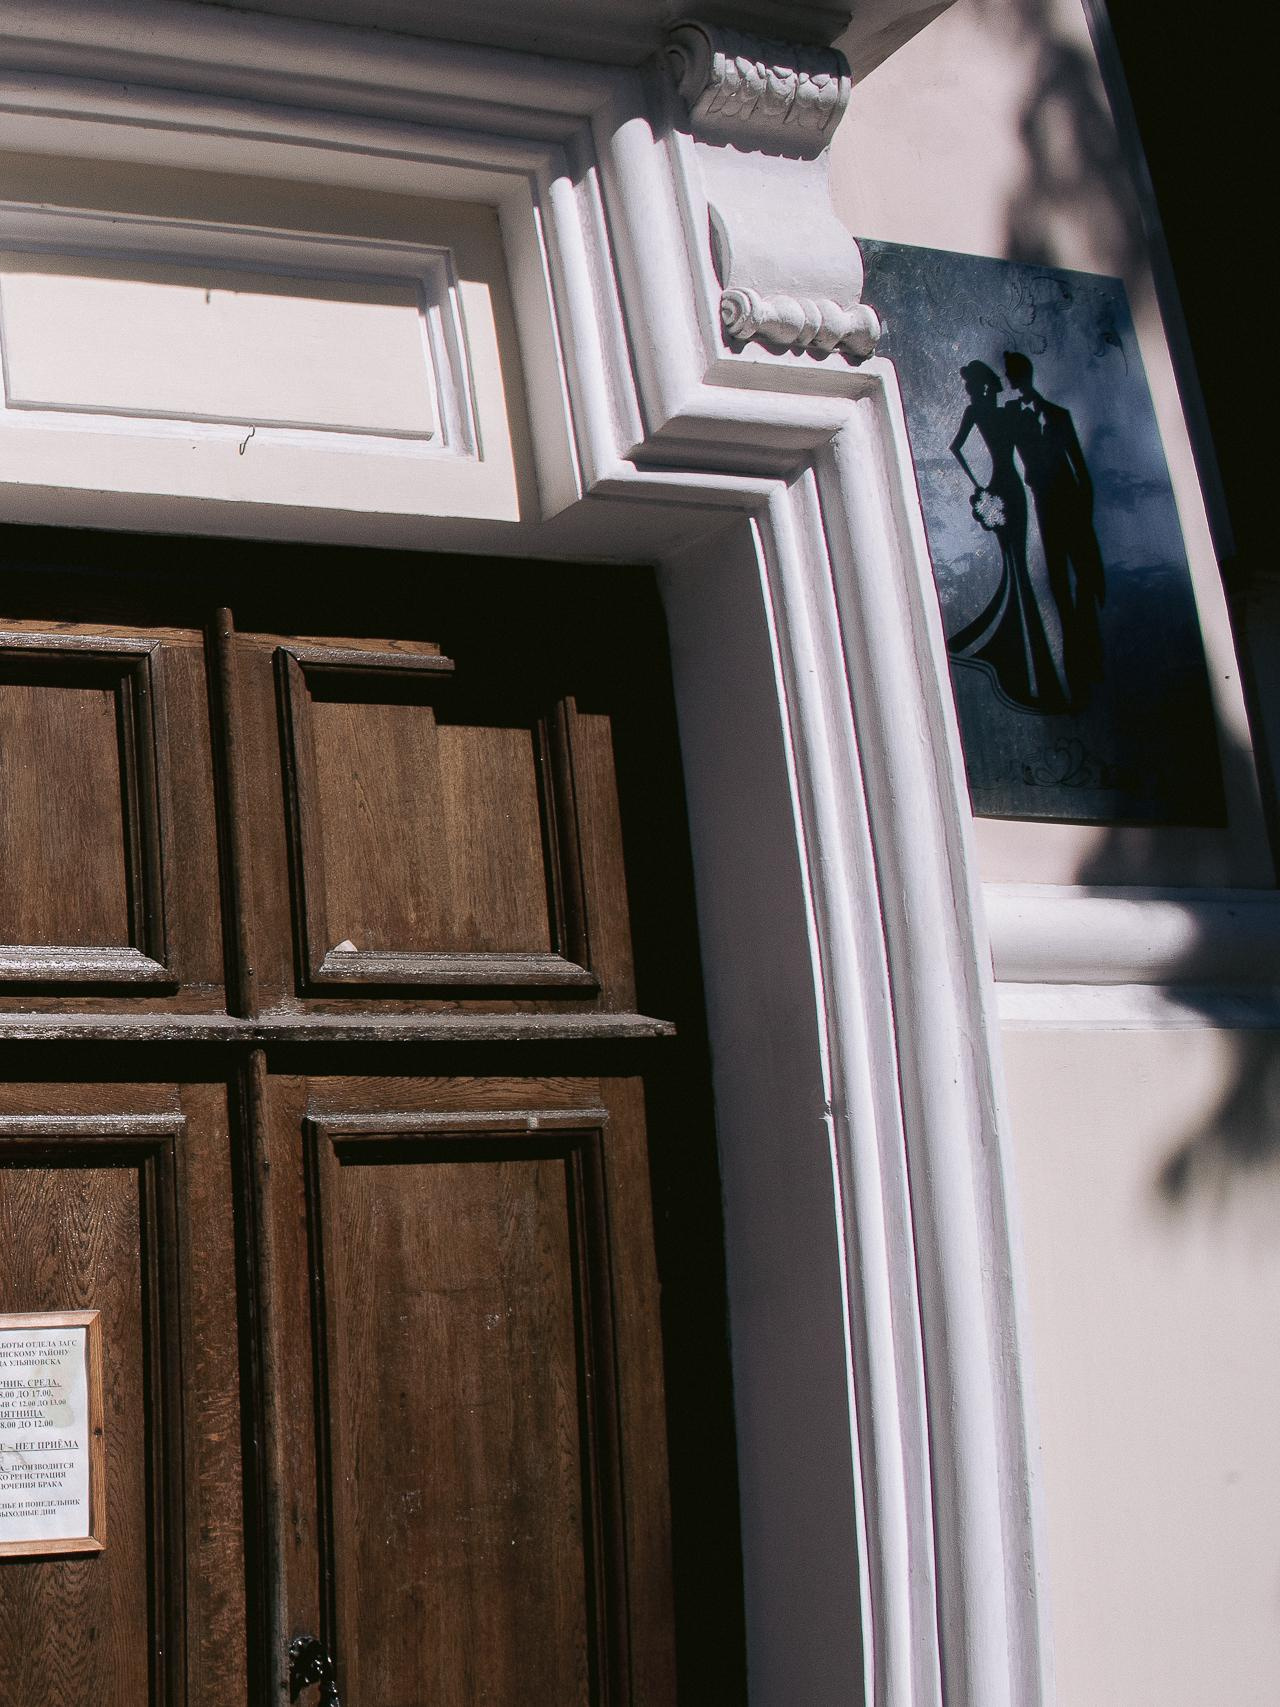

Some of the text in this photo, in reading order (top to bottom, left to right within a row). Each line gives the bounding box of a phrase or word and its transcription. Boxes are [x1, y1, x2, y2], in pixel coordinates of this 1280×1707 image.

[15, 1442, 35, 1451] НЕТ
[38, 1440, 79, 1450] ПРИЁМА
[12, 1463, 74, 1471] ПРОИЗВОДИТСЯ
[10, 1472, 66, 1480] РЕГИСТРАЦИЯ
[26, 1499, 81, 1508] ПОНЕДЕЛЬНИК
[41, 1508, 56, 1516] ДНИ
